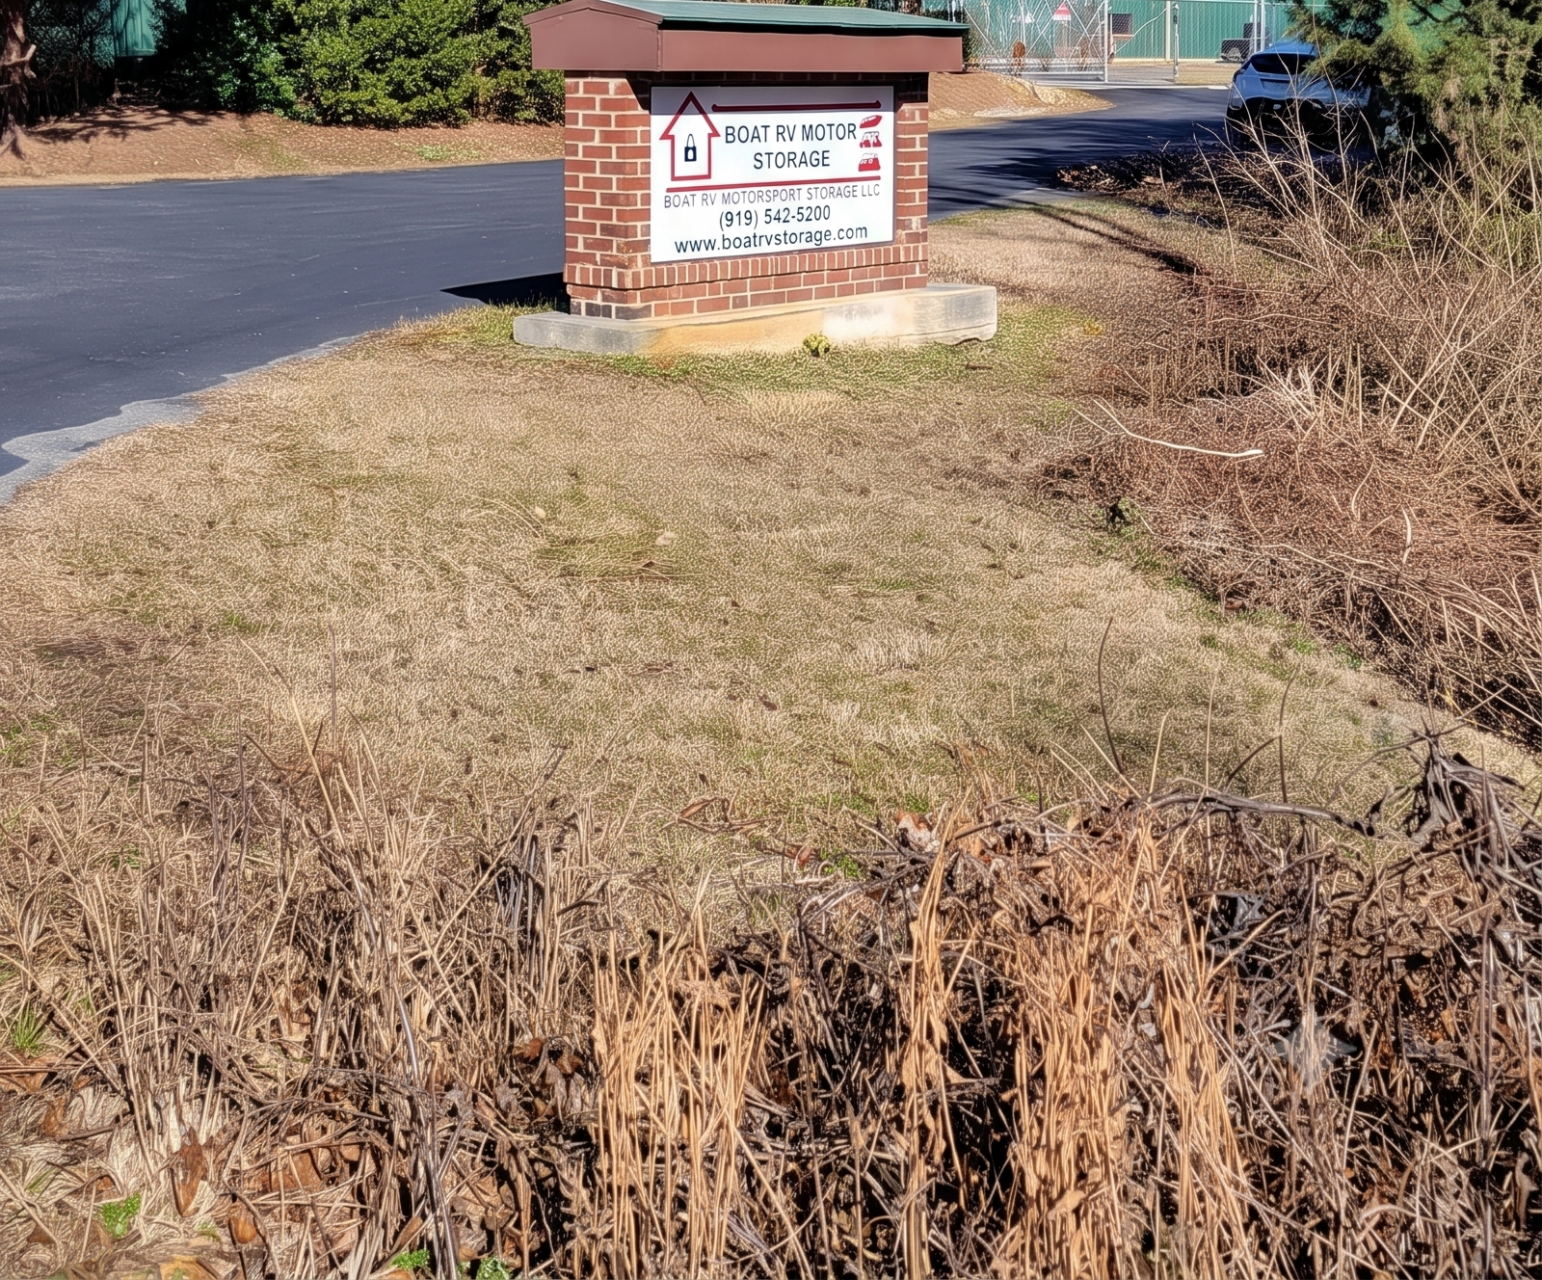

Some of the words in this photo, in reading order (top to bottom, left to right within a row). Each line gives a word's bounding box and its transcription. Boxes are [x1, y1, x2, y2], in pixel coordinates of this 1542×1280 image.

[725, 125, 770, 144] BOAT
[776, 125, 797, 142] RV
[802, 123, 857, 141] MOTOR
[753, 150, 830, 169] STORAGE
[664, 194, 697, 208] BOAT
[702, 193, 717, 206] RV
[721, 188, 802, 205] MOTORSPORT
[807, 186, 858, 200] STORAGE
[861, 184, 880, 197] LLC
[719, 209, 758, 231] (919)
[764, 205, 831, 225] 542-5200
[674, 226, 868, 254] www.boatrvstorage.com
